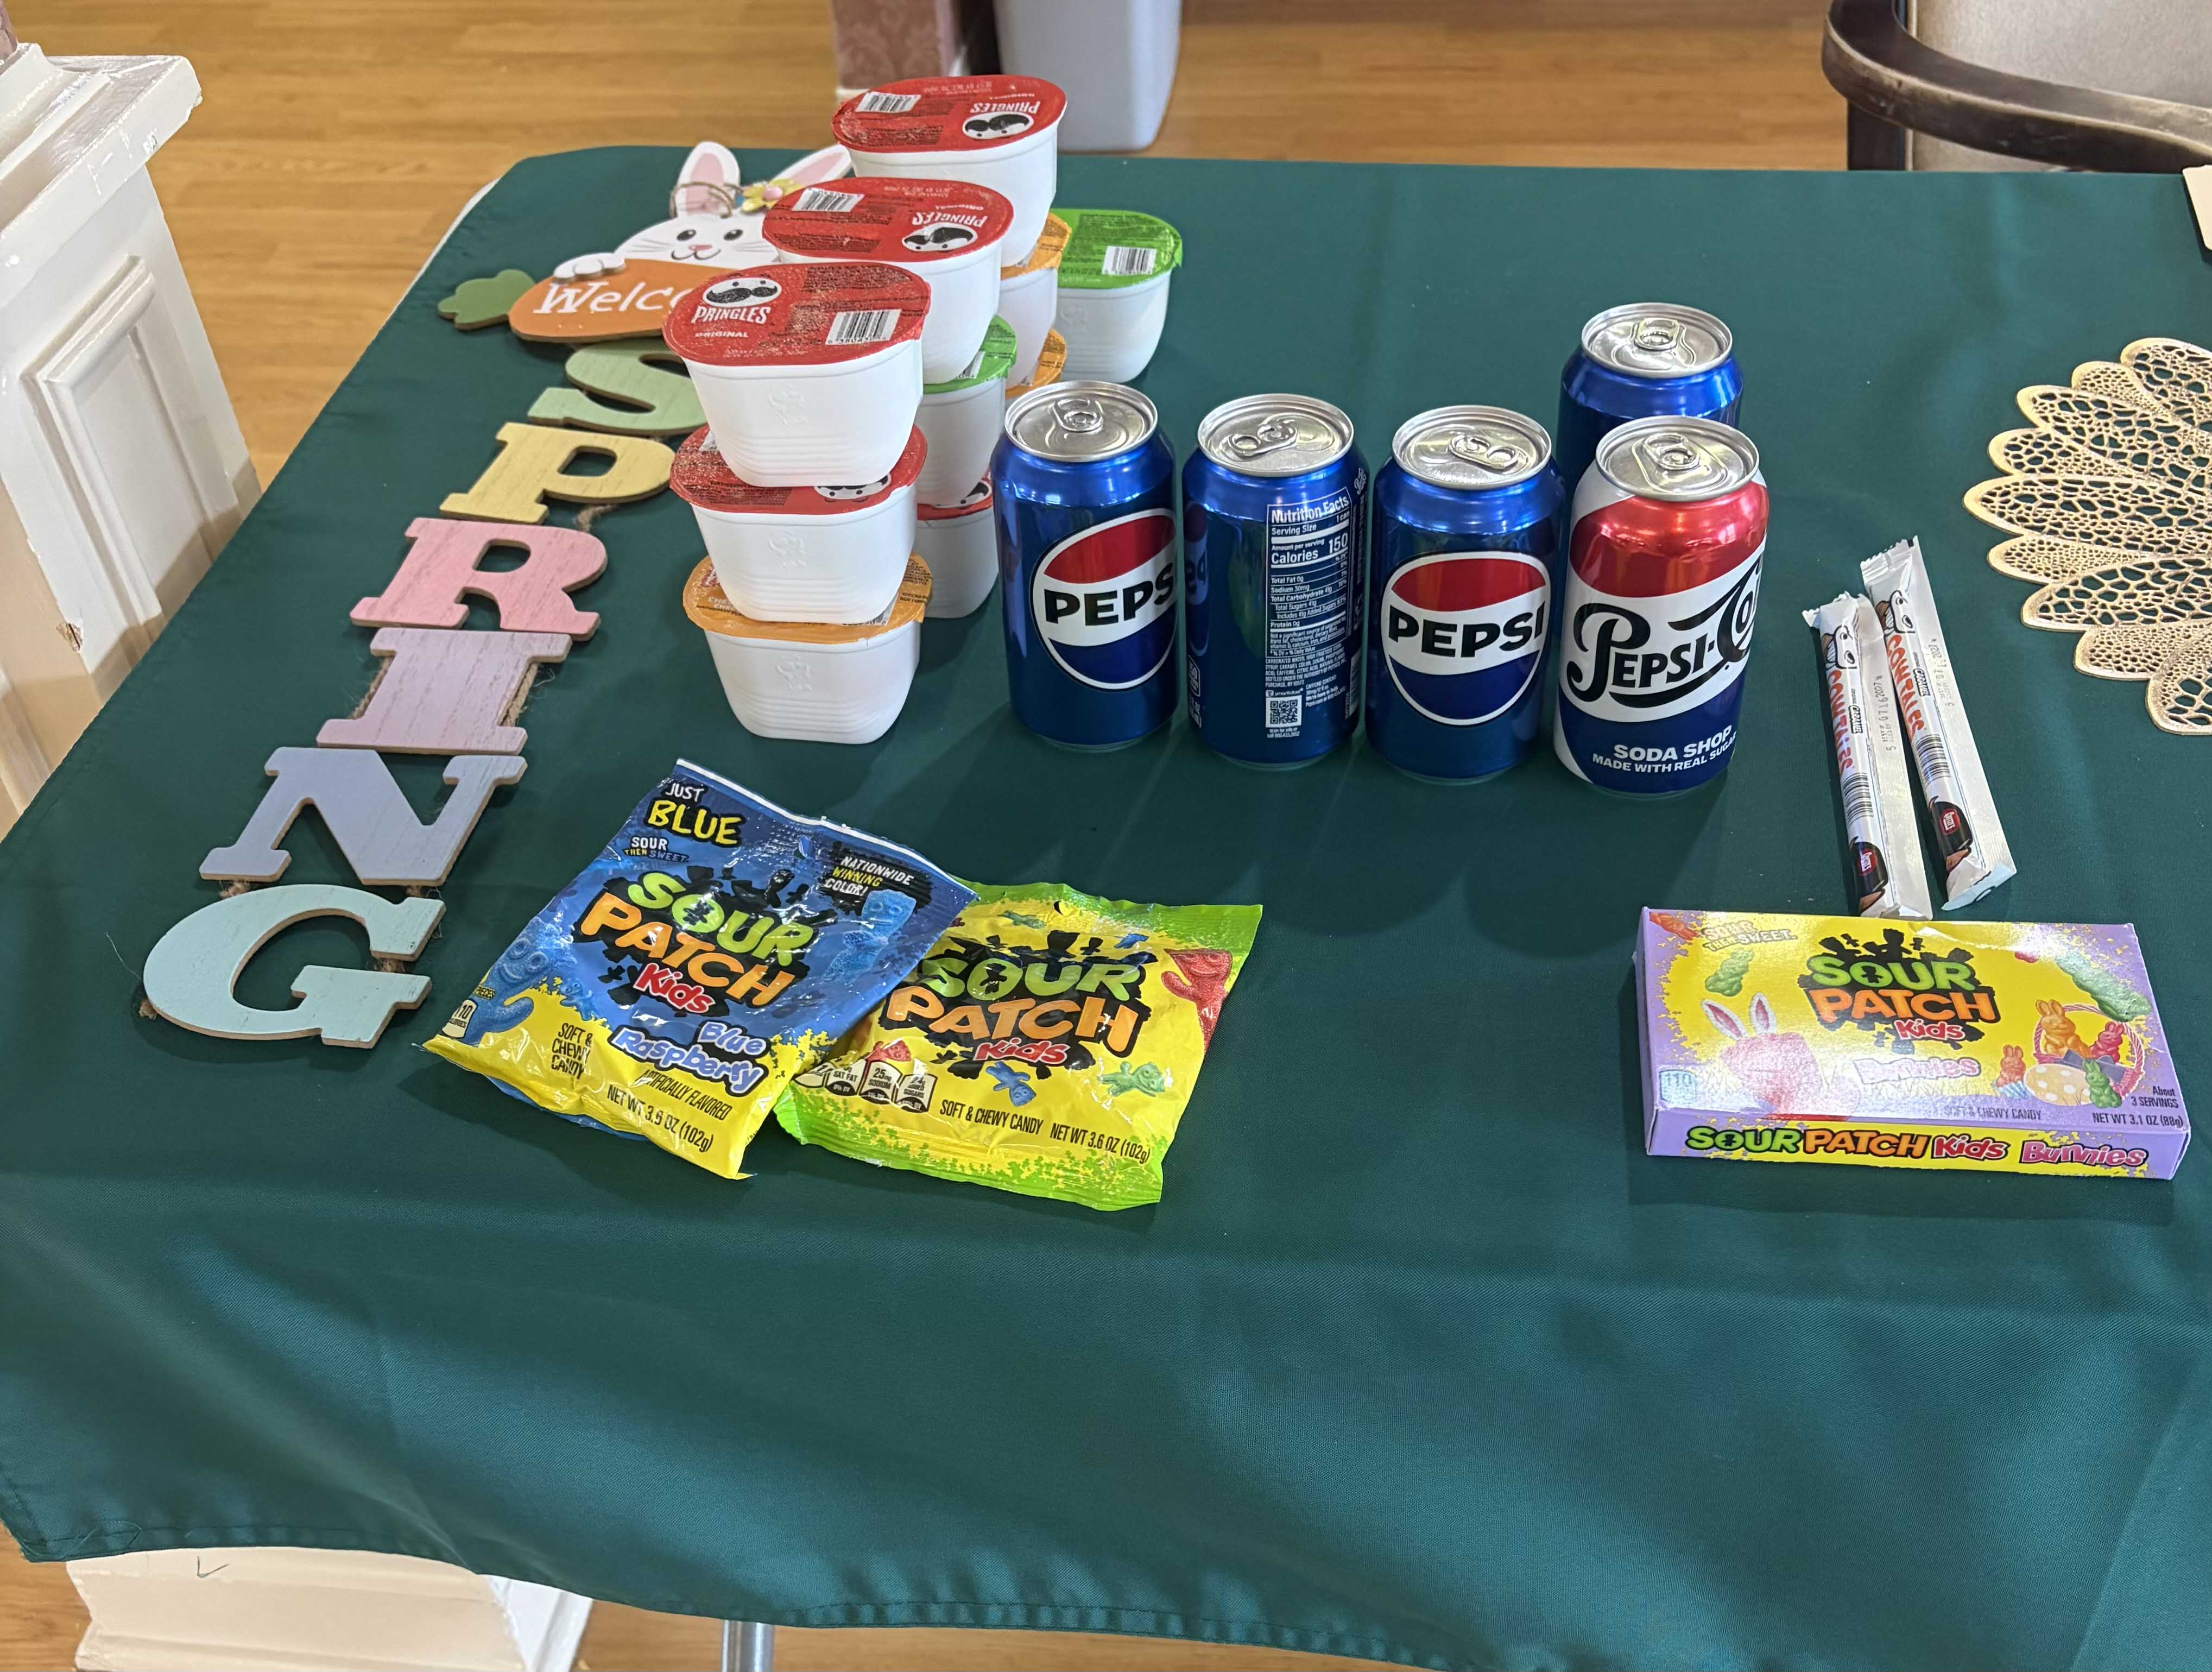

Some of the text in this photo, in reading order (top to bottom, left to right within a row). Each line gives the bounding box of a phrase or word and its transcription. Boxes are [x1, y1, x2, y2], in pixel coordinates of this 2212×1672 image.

[970, 101, 1041, 114] PRINGLES
[912, 212, 988, 228] PRINGLES
[691, 307, 771, 324] PRINGLES
[1272, 496, 1349, 523] Nutrition Facts
[1271, 524, 1317, 535] Serving Size
[1271, 550, 1318, 564] Calories
[1329, 533, 1348, 554] 150
[1286, 590, 1324, 601] Carbohydrate
[1288, 602, 1307, 610] Sugars
[1388, 601, 1546, 658] PEPSI
[1913, 668, 1931, 697] CARAMEL
[1848, 705, 1863, 734] CARAMEL
[1614, 725, 1732, 761] SODA SHOP
[1592, 753, 1631, 772] MADE
[1634, 762, 1672, 773] WITH
[1674, 753, 1708, 771] REAL
[666, 783, 704, 802] JUST
[647, 800, 742, 844] BLUE
[631, 837, 668, 851] SOUR
[832, 867, 883, 887] WINNING
[840, 856, 914, 886] NATIONWIDE
[824, 879, 869, 897] COLOR!
[628, 872, 813, 967] SOUR
[581, 892, 795, 1006] PATCH
[920, 957, 1140, 1001] SOUR
[1809, 956, 1976, 990] SOUR
[633, 962, 717, 1014] Kids
[886, 986, 1139, 1052] PATCH
[1809, 988, 1995, 1023] PATCH
[558, 1023, 593, 1048] SOFT &
[697, 1021, 767, 1056] Blue
[1895, 1019, 1965, 1040] Kids
[552, 1038, 591, 1061] CHEWY
[610, 1027, 764, 1094] Raspberry
[972, 1037, 1071, 1065] Kids
[551, 1055, 585, 1080] CANDY
[833, 1071, 858, 1082] SAT FAT
[2131, 1096, 2178, 1108] 3 SERVINGS
[2153, 1086, 2176, 1096] About
[607, 1084, 627, 1106] NET
[679, 1121, 714, 1153] (102g)
[685, 1090, 733, 1121] FLAVORED
[1977, 1107, 2009, 1118] CHEWY
[2012, 1109, 2042, 1120] CANDY
[940, 1099, 1151, 1164] SOFT & CHEWY CANDY NET WT 3.6 OZ (102g)
[2093, 1113, 2183, 1128] NET WT 3.1 OZ (88g)
[1686, 1126, 2148, 1166] SOUR PATCH Kids Bunnies
